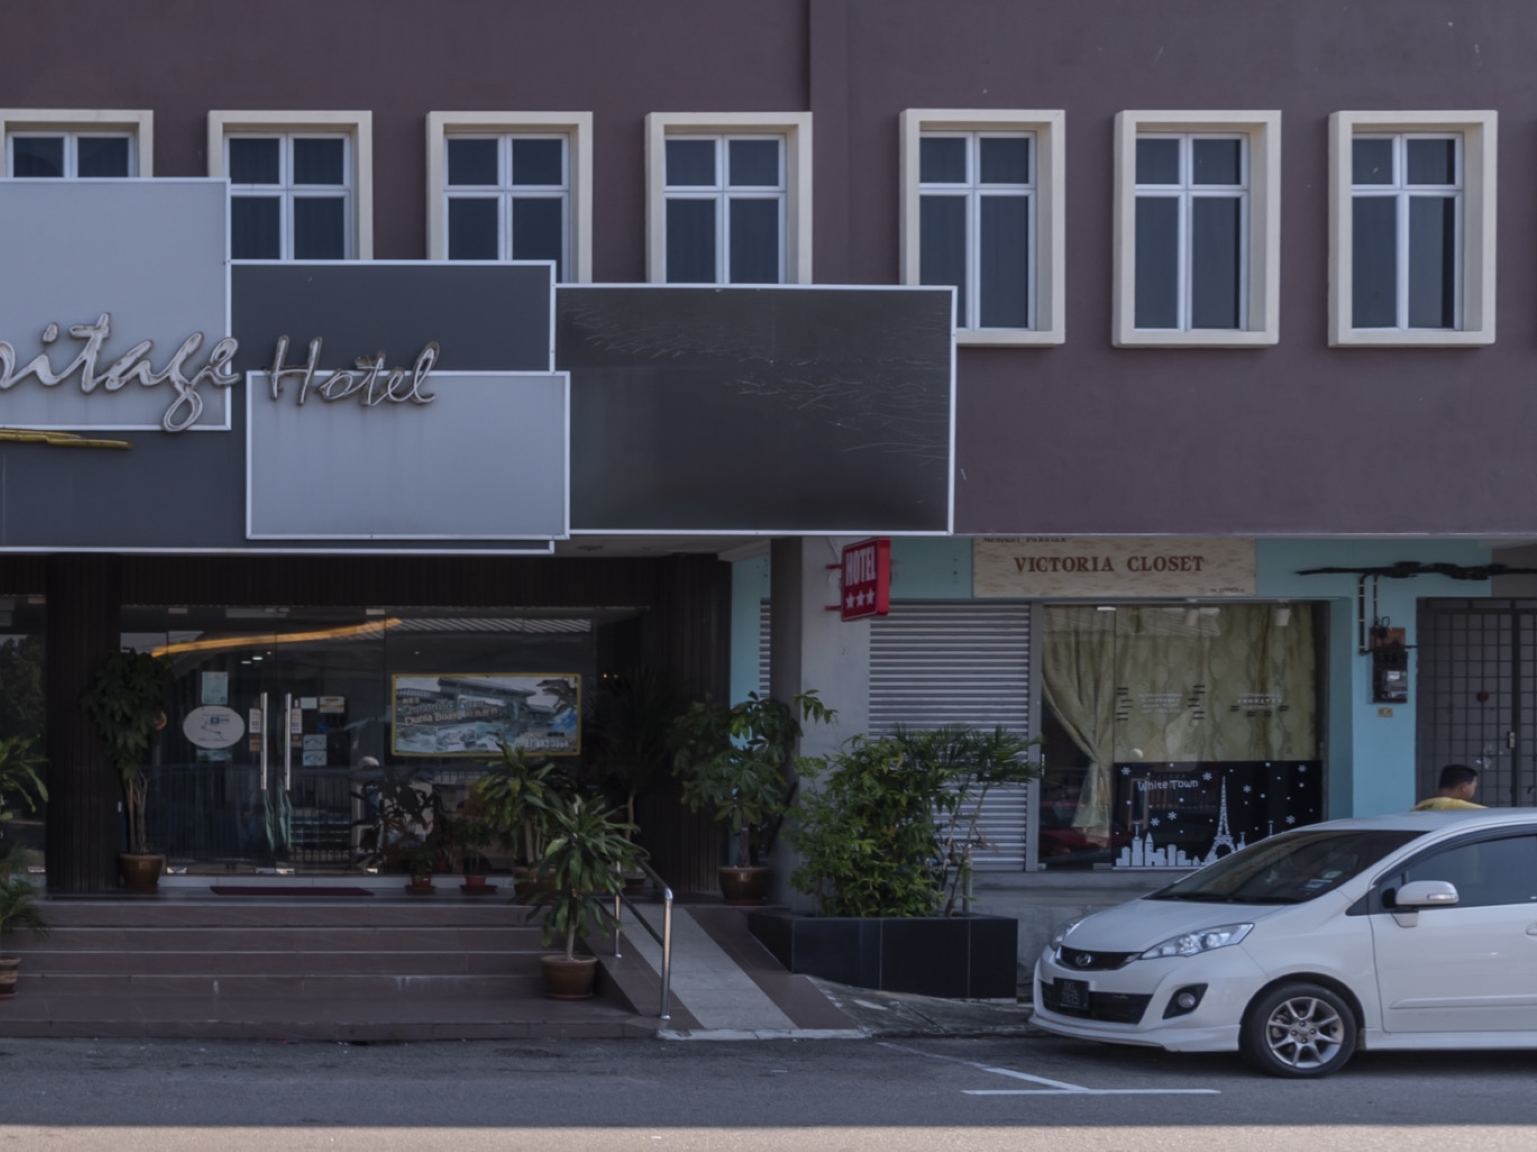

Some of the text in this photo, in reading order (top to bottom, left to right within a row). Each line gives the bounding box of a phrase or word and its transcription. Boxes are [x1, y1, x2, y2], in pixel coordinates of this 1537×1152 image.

[267, 335, 440, 406] Hotel
[845, 546, 877, 587] HOTEL
[1013, 555, 1205, 573] VICTORIA CLOSET
[1137, 780, 1199, 792] White Town
